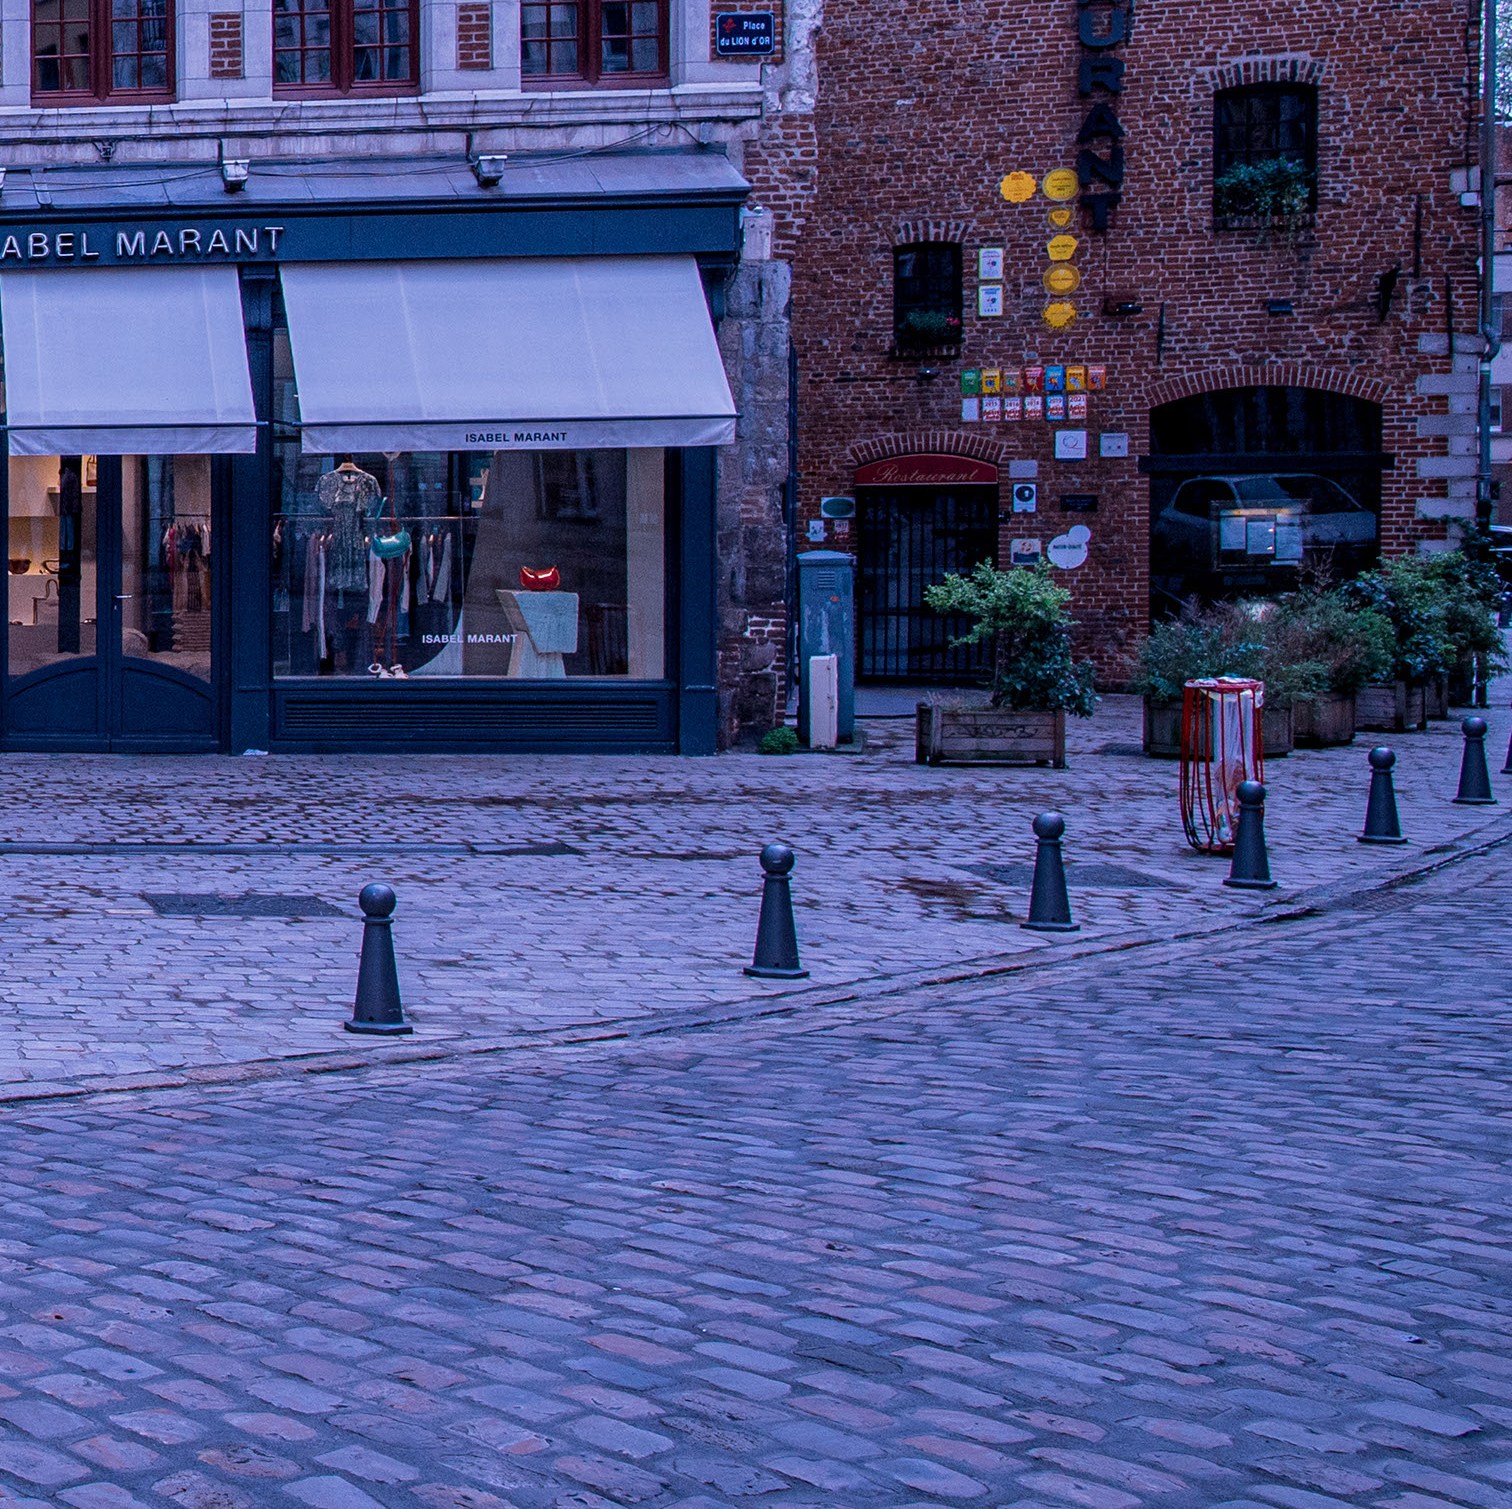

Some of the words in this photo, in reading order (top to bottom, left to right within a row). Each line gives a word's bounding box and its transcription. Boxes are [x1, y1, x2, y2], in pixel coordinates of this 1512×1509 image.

[743, 21, 765, 30] Place
[720, 38, 730, 46] du
[731, 36, 749, 46] LION
[751, 36, 770, 45] d'OR
[116, 226, 285, 257] MARANT
[465, 433, 510, 442] ISABEL
[514, 432, 568, 442] MARANT
[872, 463, 980, 482] Restaurant
[422, 634, 464, 644] ISABEL
[467, 634, 518, 643] MARANT
